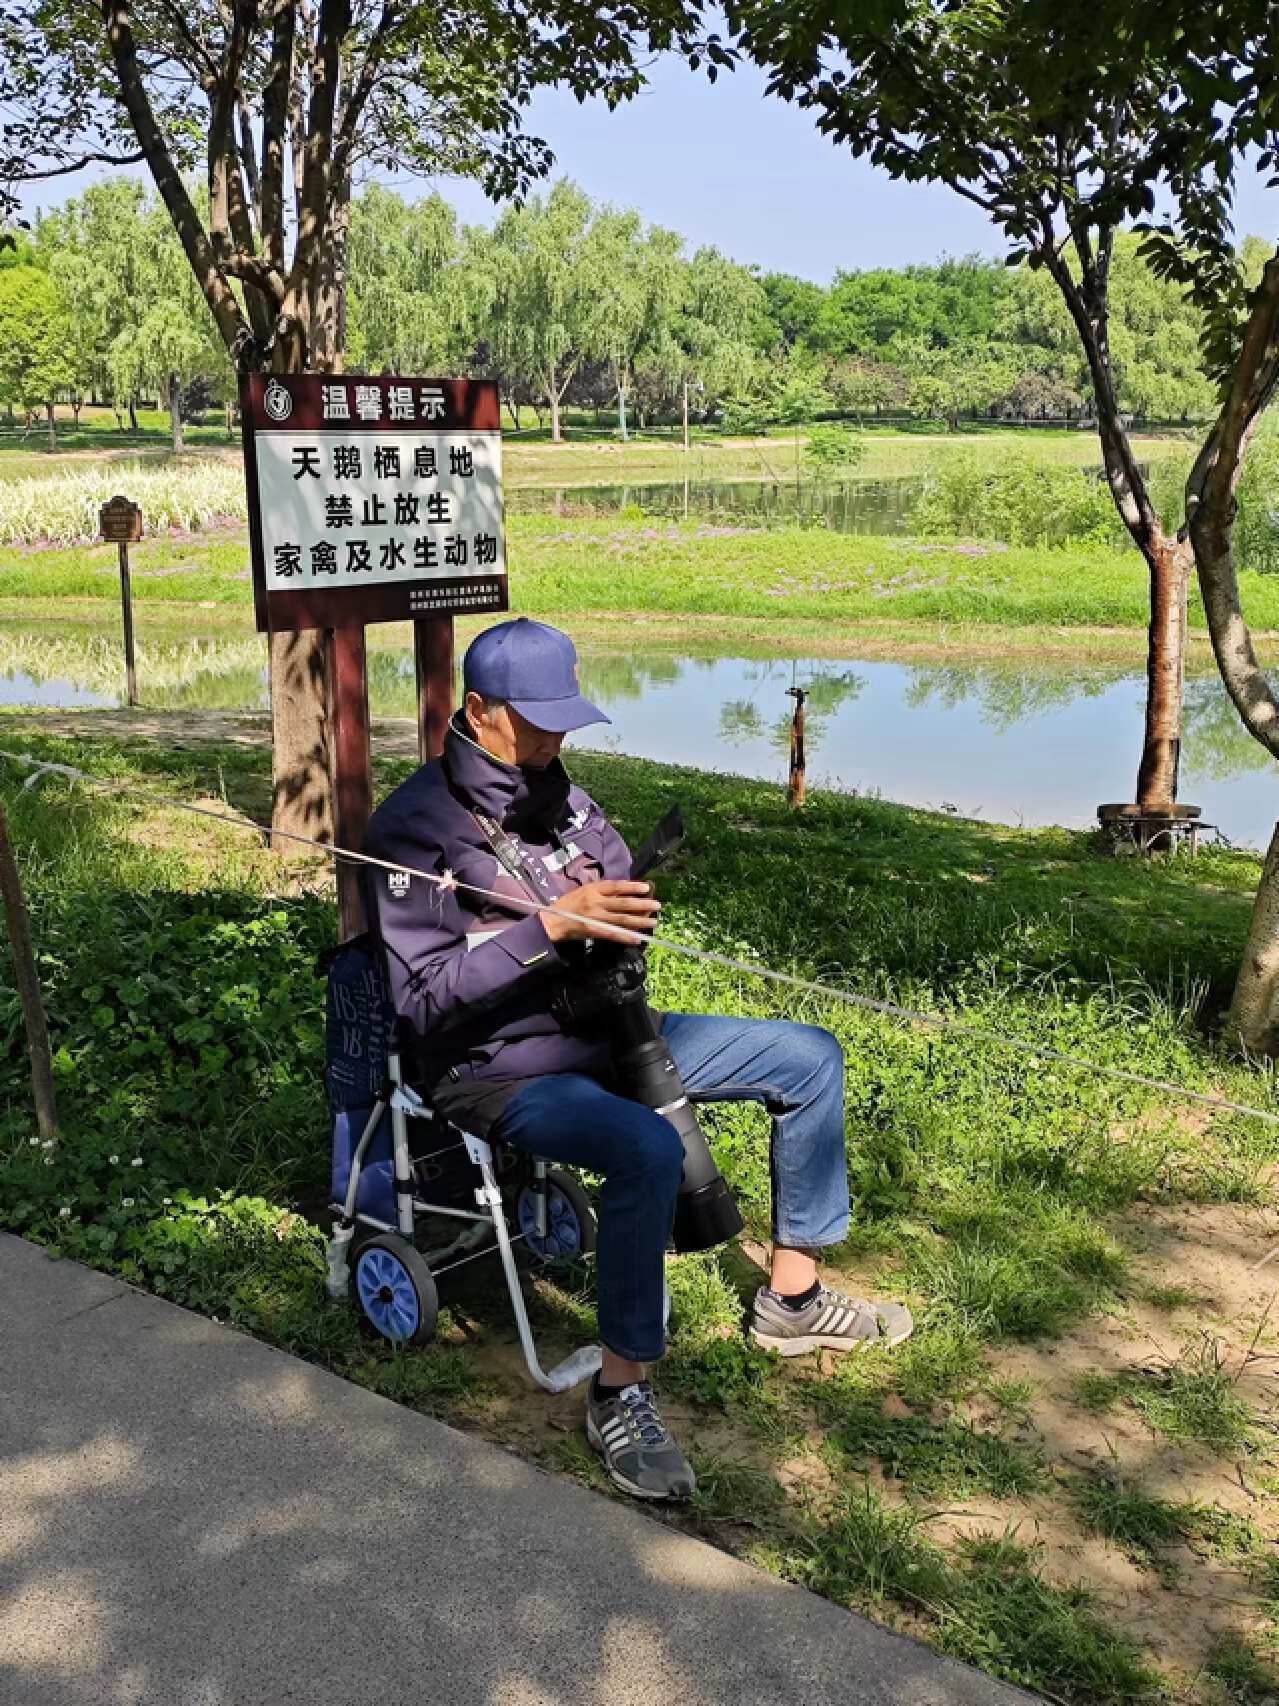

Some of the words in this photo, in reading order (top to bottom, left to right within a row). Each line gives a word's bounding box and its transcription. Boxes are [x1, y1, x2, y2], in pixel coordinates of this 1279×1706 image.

[322, 385, 446, 421] 温馨提示
[291, 445, 474, 480] 天鹅栖息地
[325, 491, 452, 528] 禁止放生
[273, 533, 497, 577] 家禽及水生动物
